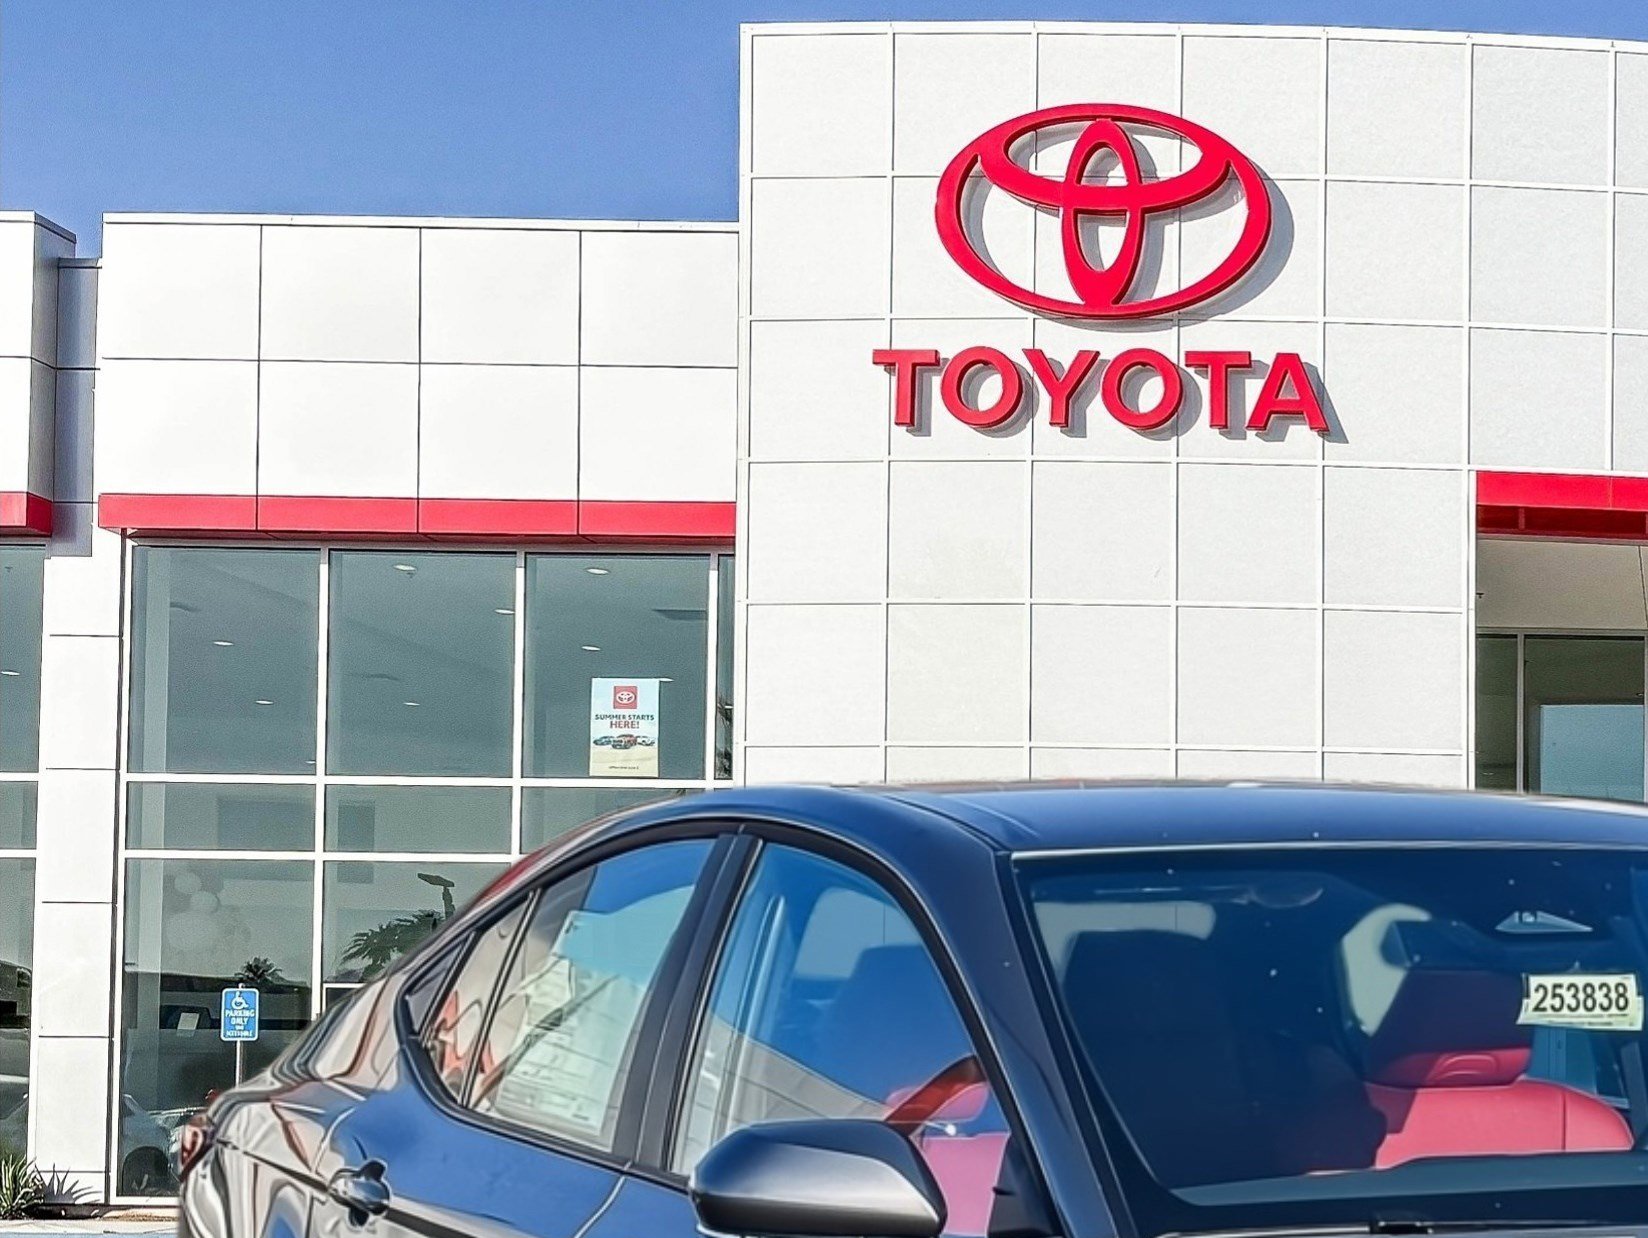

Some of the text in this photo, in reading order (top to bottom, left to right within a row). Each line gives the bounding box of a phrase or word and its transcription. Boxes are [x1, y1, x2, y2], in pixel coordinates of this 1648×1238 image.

[873, 346, 1331, 434] TOYOTA
[609, 721, 640, 729] HERE!
[1532, 982, 1629, 1013] 253838
[225, 1009, 255, 1017] PARKING
